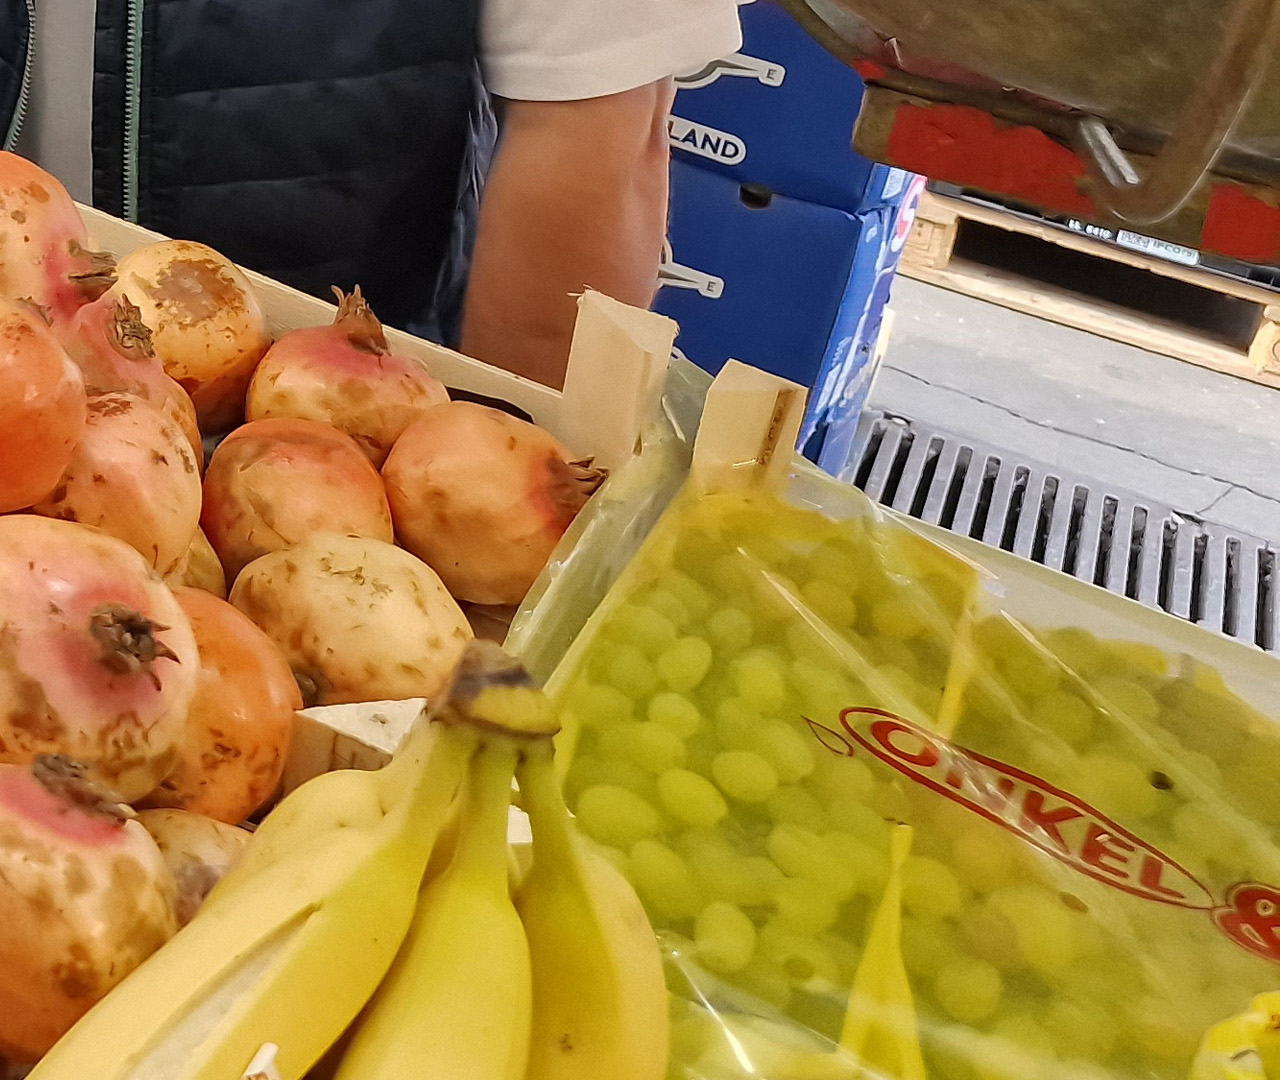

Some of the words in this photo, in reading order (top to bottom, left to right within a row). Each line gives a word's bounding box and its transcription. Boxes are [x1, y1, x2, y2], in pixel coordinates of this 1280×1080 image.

[767, 68, 777, 80] E
[706, 281, 716, 293] E
[870, 720, 1187, 899] ONKEL
